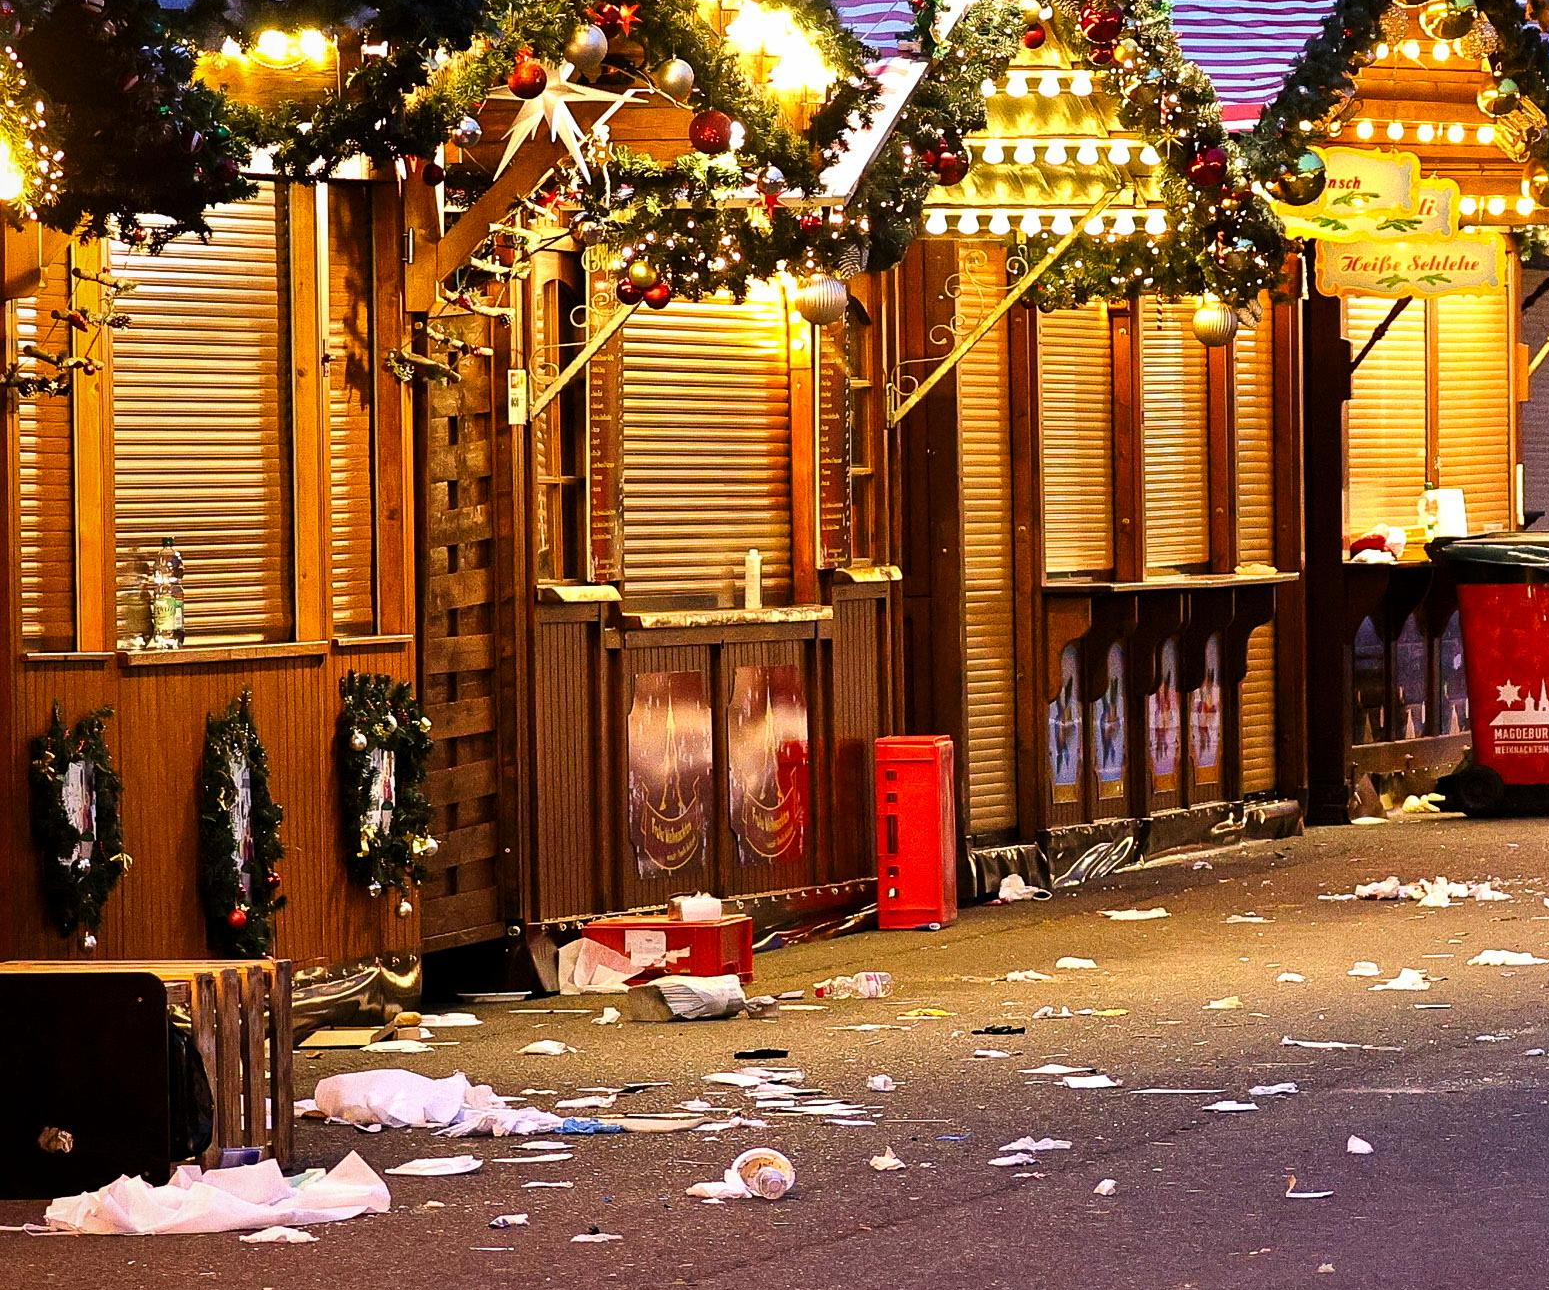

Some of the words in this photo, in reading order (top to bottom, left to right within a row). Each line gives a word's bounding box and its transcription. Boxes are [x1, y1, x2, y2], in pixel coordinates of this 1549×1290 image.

[1327, 176, 1361, 189] nsch
[1341, 256, 1401, 274] Heiße
[1407, 255, 1479, 271] Schlehe
